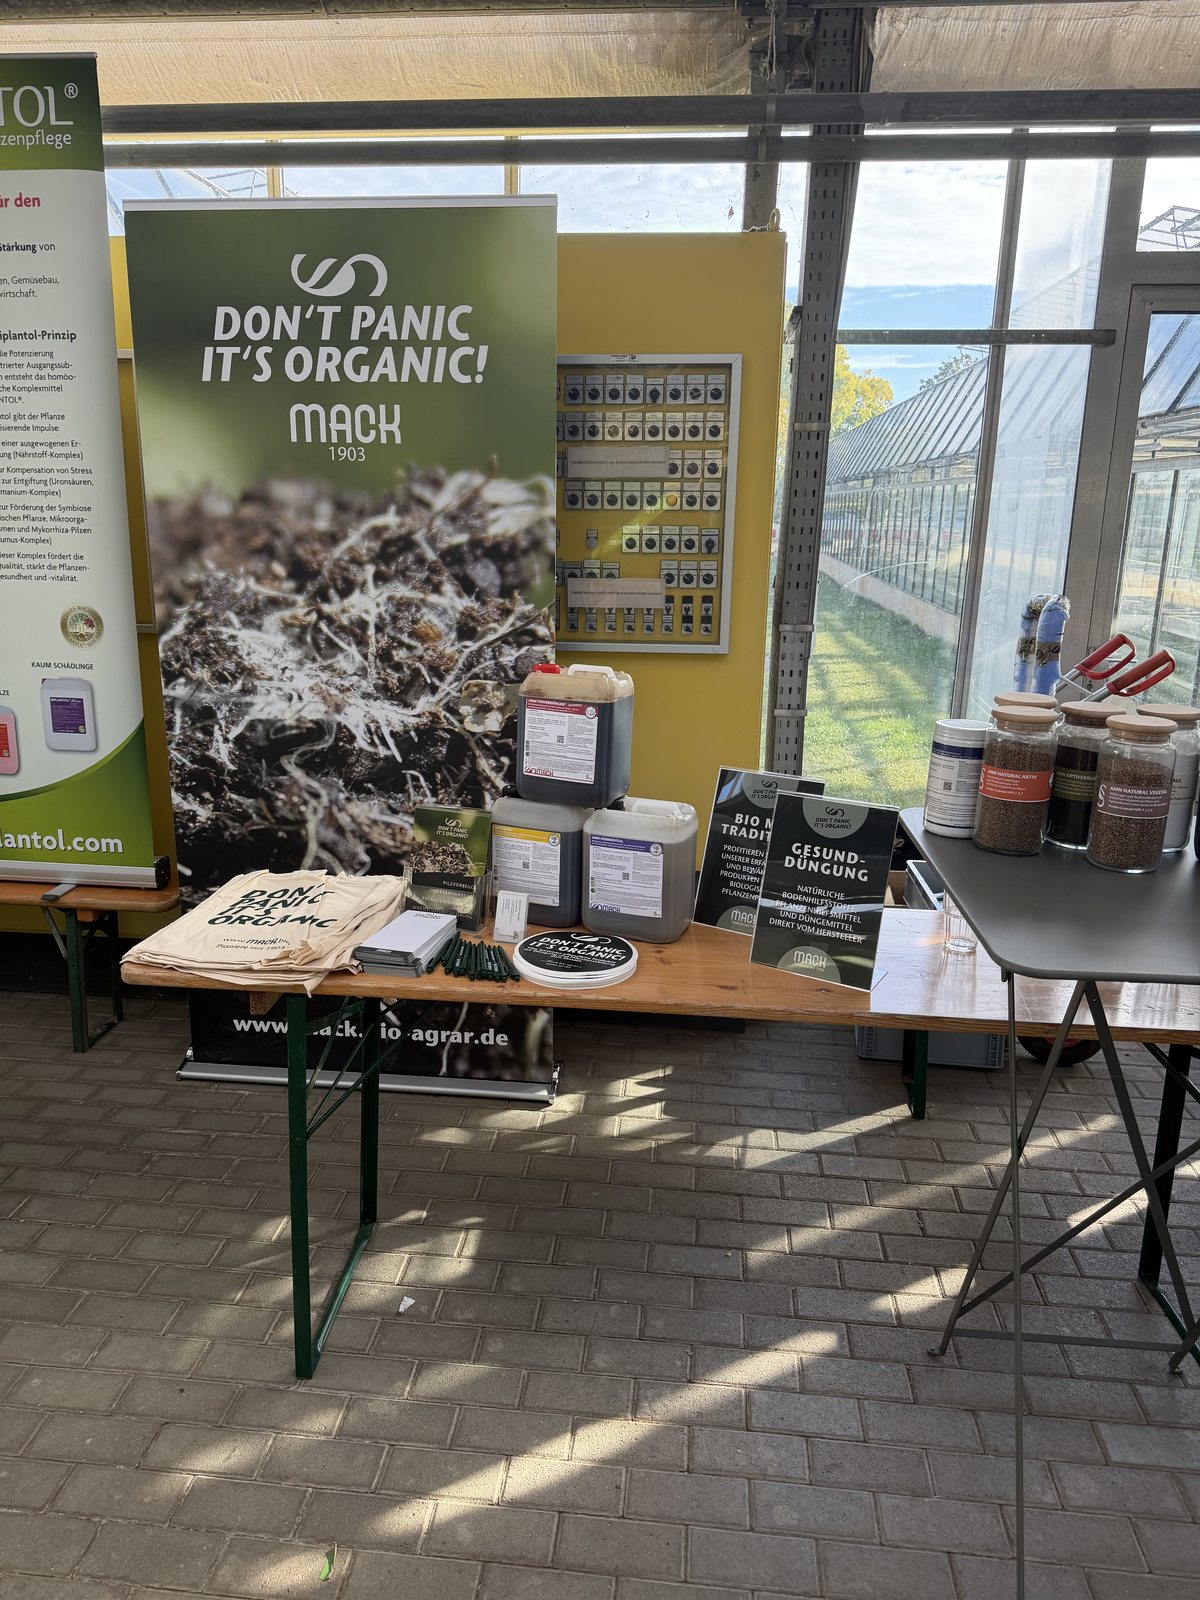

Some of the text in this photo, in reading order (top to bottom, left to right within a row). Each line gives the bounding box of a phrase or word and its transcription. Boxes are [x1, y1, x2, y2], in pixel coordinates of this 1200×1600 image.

[14, 192, 41, 208] den
[39, 243, 56, 251] von
[214, 304, 473, 341] DON'T PANIC
[10, 349, 55, 359] Potenzierung
[201, 344, 489, 384] IT'S ORGANIC!
[35, 373, 46, 381] das
[13, 412, 26, 422] gibt
[28, 412, 39, 420] der
[41, 412, 66, 421] Pflanze
[289, 403, 402, 444] MACK
[20, 440, 70, 449] ausgewogenen
[328, 446, 366, 461] 1903
[7, 466, 55, 475] Kompensation
[71, 467, 93, 475] Stress
[14, 477, 48, 487] Entgiftung
[58, 504, 92, 514] Symbiose
[17, 525, 30, 533] und
[17, 551, 46, 561] Komplex
[73, 552, 84, 561] die
[47, 563, 57, 571] die
[34, 573, 47, 581] und
[53, 662, 95, 671] SCHÄDLINGE
[734, 813, 760, 829] BIO
[723, 844, 765, 858] PROFITIEREN
[791, 843, 866, 865] GESUND-
[721, 853, 747, 864] UNSERER
[726, 862, 743, 873] UND
[784, 854, 868, 882] DÜNGUNG
[720, 870, 760, 884] PRODUKTEN
[797, 884, 845, 900] NATÜRLICHE
[775, 899, 862, 924] PFLANZENHILFSMITTEL
[208, 915, 338, 928] ORGANIC
[780, 910, 854, 932] UND DÜNGEMITTEL
[769, 917, 795, 929] DIREKT
[796, 921, 815, 933] VOM
[816, 926, 863, 944] HERSTELLER
[539, 937, 627, 955] DON'T PANIC
[558, 946, 627, 961] ORGANIC!
[793, 950, 827, 969] MACK
